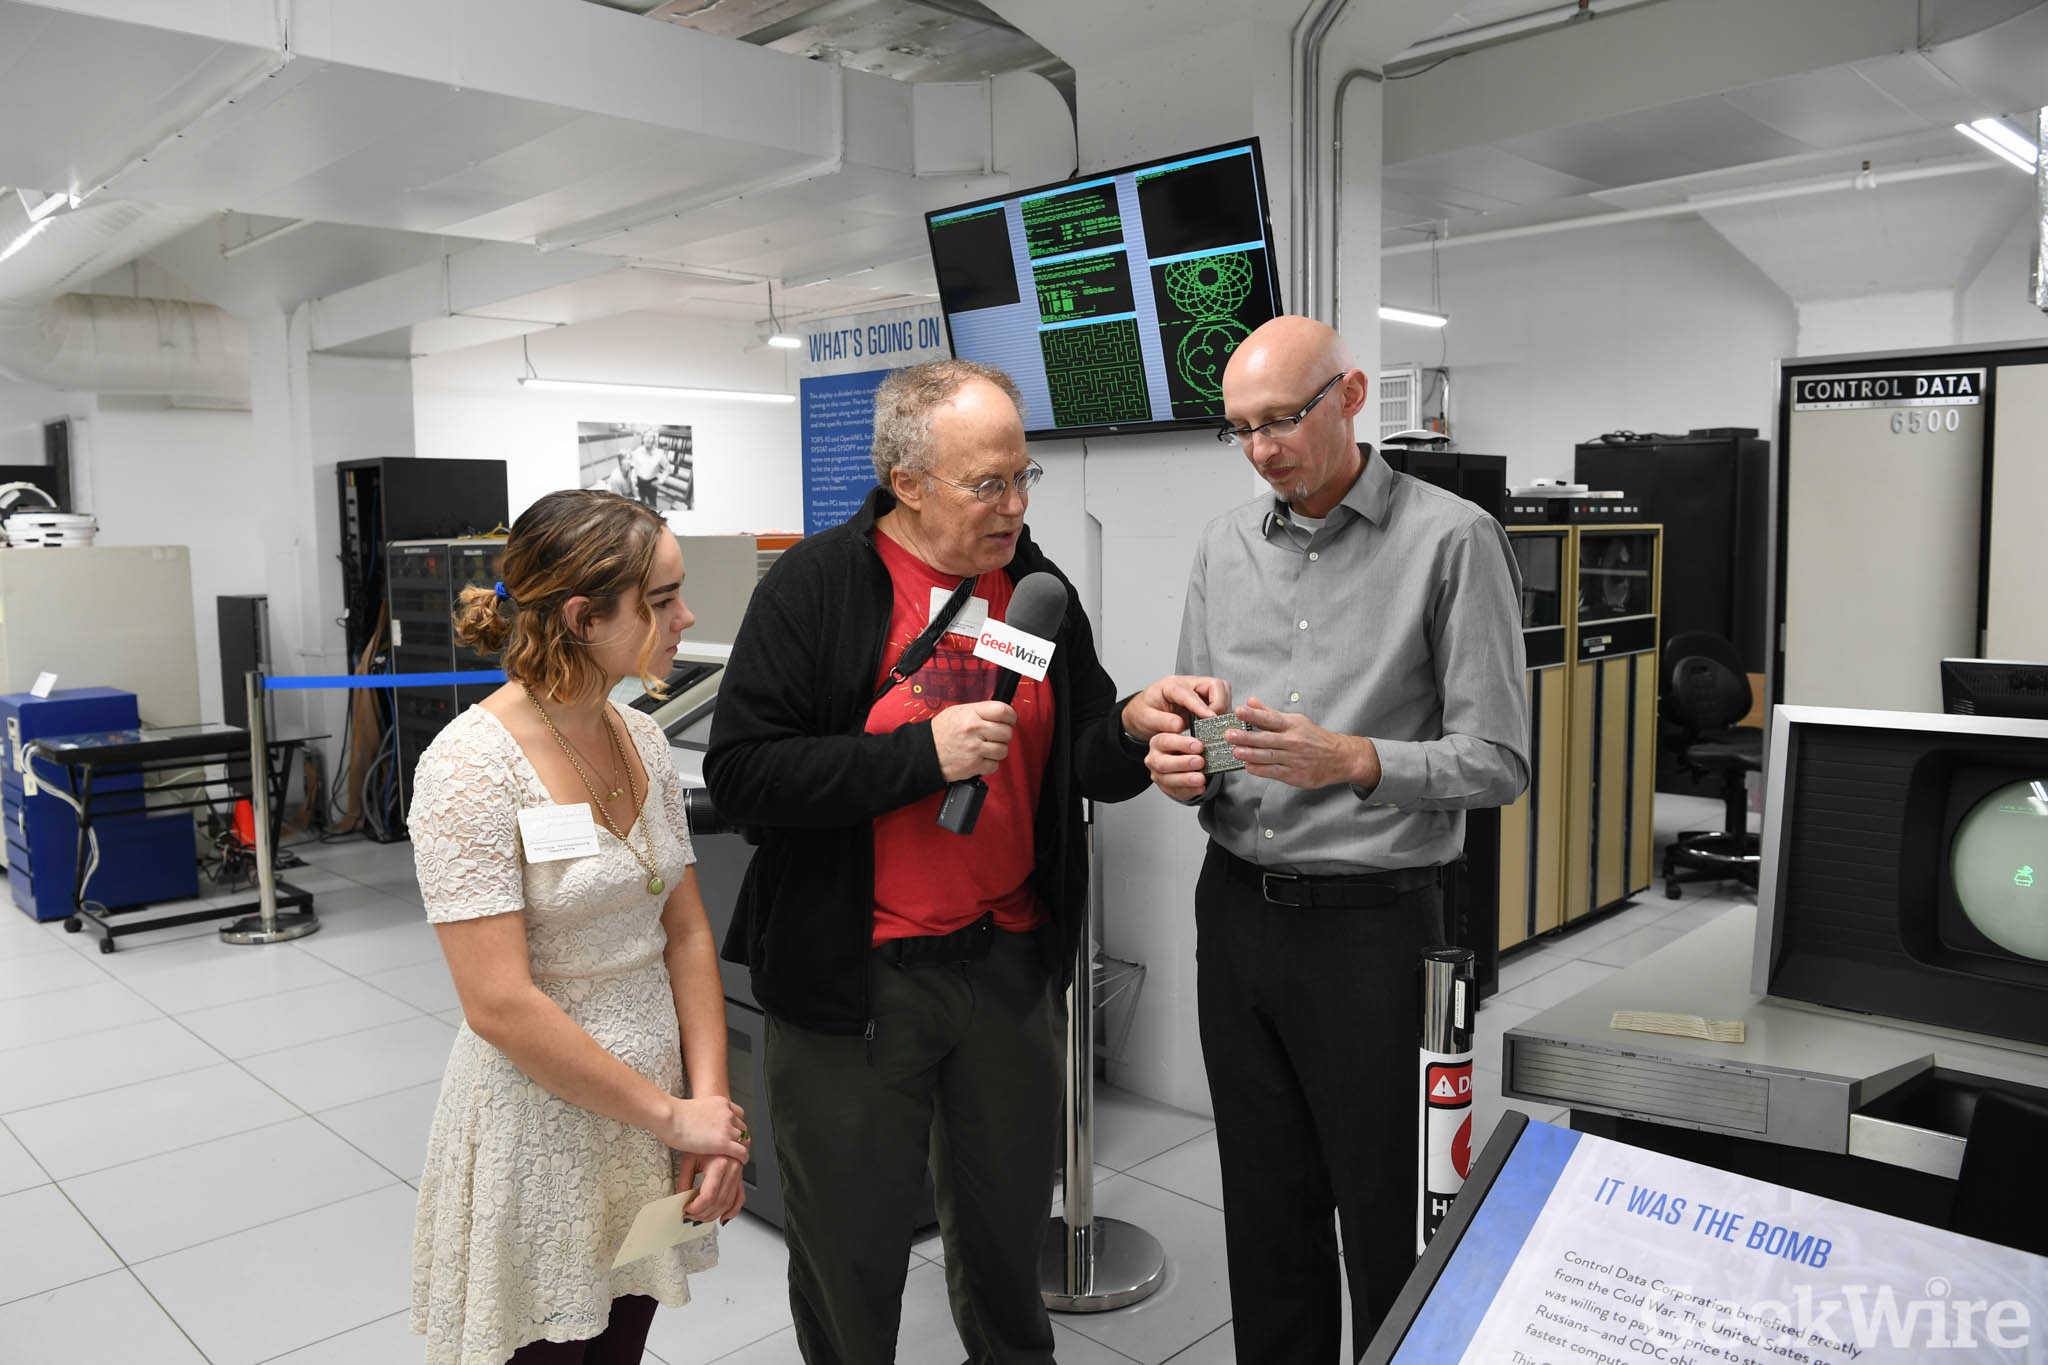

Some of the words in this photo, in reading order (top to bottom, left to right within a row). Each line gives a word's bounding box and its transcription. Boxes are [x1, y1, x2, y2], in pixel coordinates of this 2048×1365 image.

[809, 328, 862, 362] WHAT'S
[868, 321, 912, 355] GOING
[918, 317, 940, 349] ON
[1804, 379, 1903, 400] CONTROL
[1916, 376, 1973, 396] DATA
[1890, 409, 1960, 433] 6500
[980, 633, 1047, 668] GeekWire
[1593, 1177, 1625, 1206] IT
[1626, 1185, 1687, 1225] WAS
[1692, 1203, 1744, 1243] THE
[1746, 1220, 1833, 1269] BOMB
[1545, 1288, 1567, 1302] was
[1570, 1298, 1610, 1321] willing
[1613, 1311, 1627, 1323] to
[1628, 1319, 1655, 1336] pay
[1657, 1329, 1682, 1344] any
[1683, 1338, 1720, 1356] price
[1724, 1349, 1739, 1363] to
[1554, 1268, 1584, 1287] from
[1587, 1281, 1609, 1296] the
[1612, 1288, 1646, 1307] Cold
[1649, 1298, 1678, 1319] War.
[1683, 1310, 1707, 1329] The
[1711, 1320, 1761, 1346] United
[1763, 1338, 1810, 1363] States
[1564, 1251, 1614, 1275] Control
[1615, 1267, 1647, 1287] Data
[1650, 1279, 1732, 1316] Corporation
[1736, 1306, 1806, 1339] benefited
[1807, 1334, 1863, 1361] greatly
[1525, 1323, 1569, 1348] fastest
[1629, 1338, 1669, 1361] CDC
